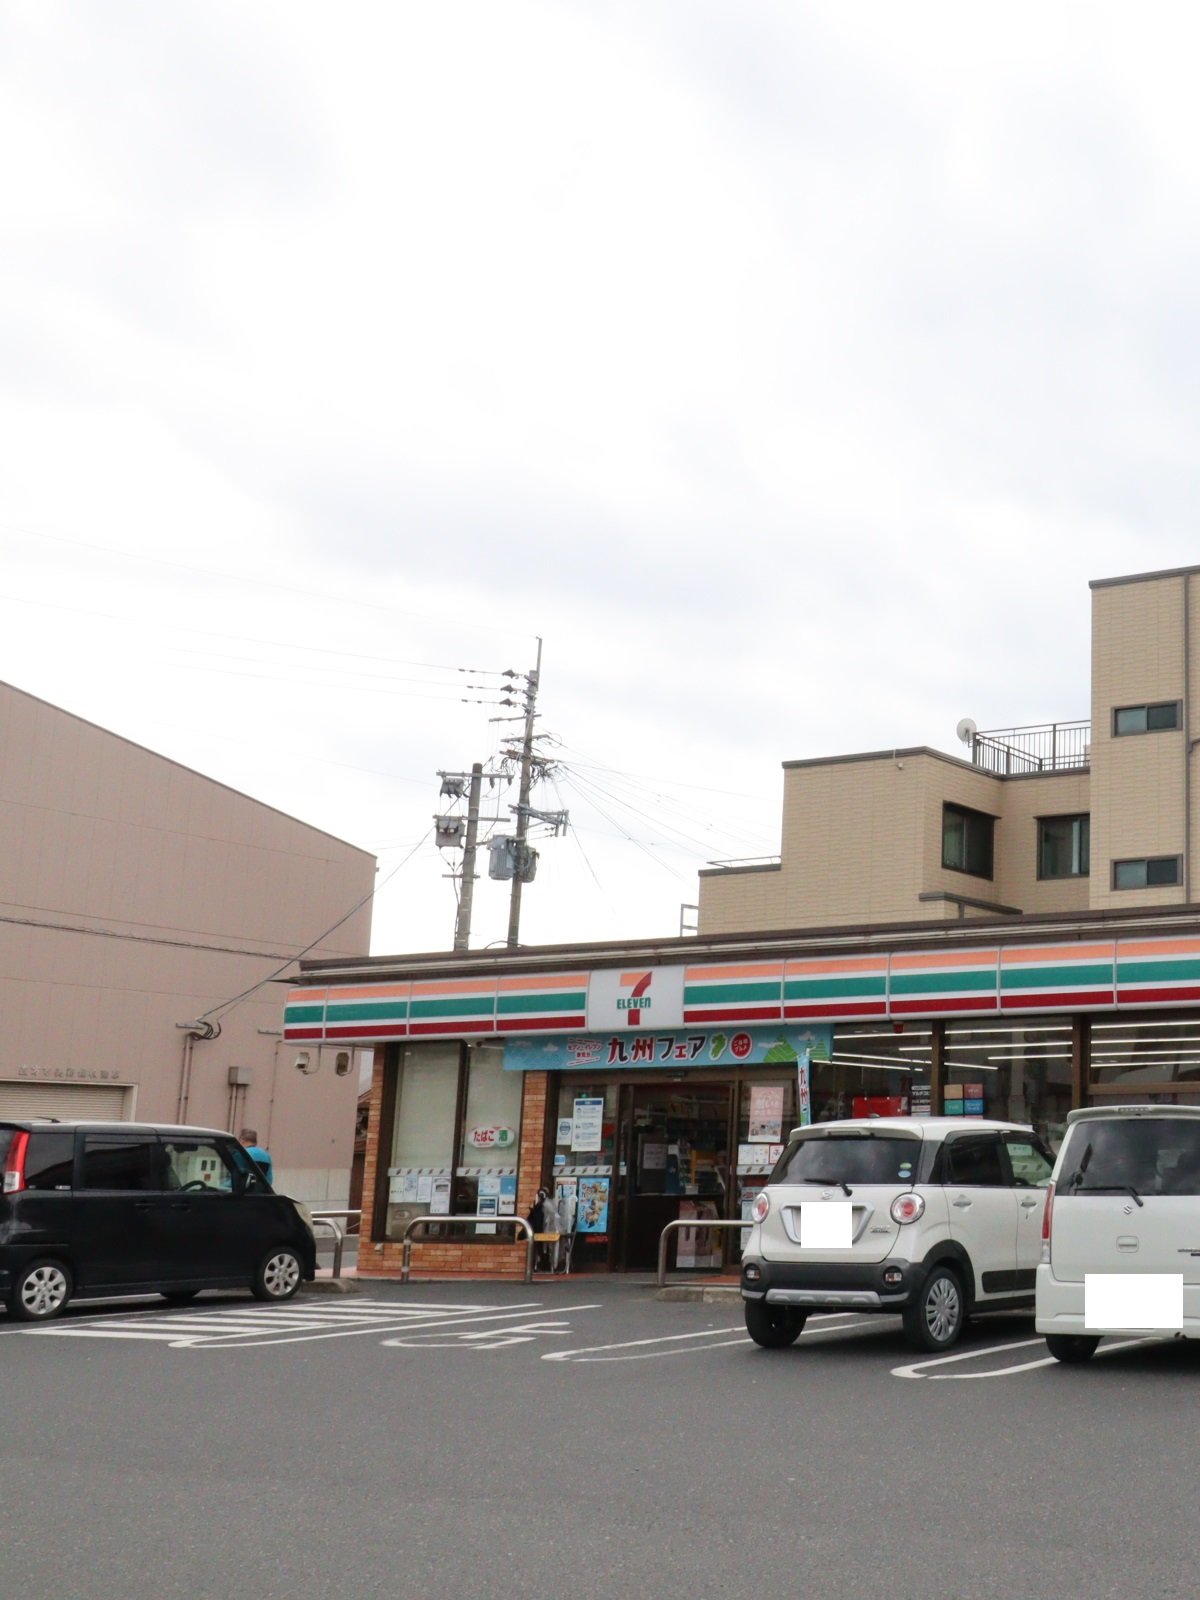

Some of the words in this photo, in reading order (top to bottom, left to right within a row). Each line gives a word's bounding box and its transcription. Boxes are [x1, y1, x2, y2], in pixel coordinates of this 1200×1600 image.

[608, 1035, 706, 1064] 九州フェア
[474, 1130, 495, 1142] たばこ
